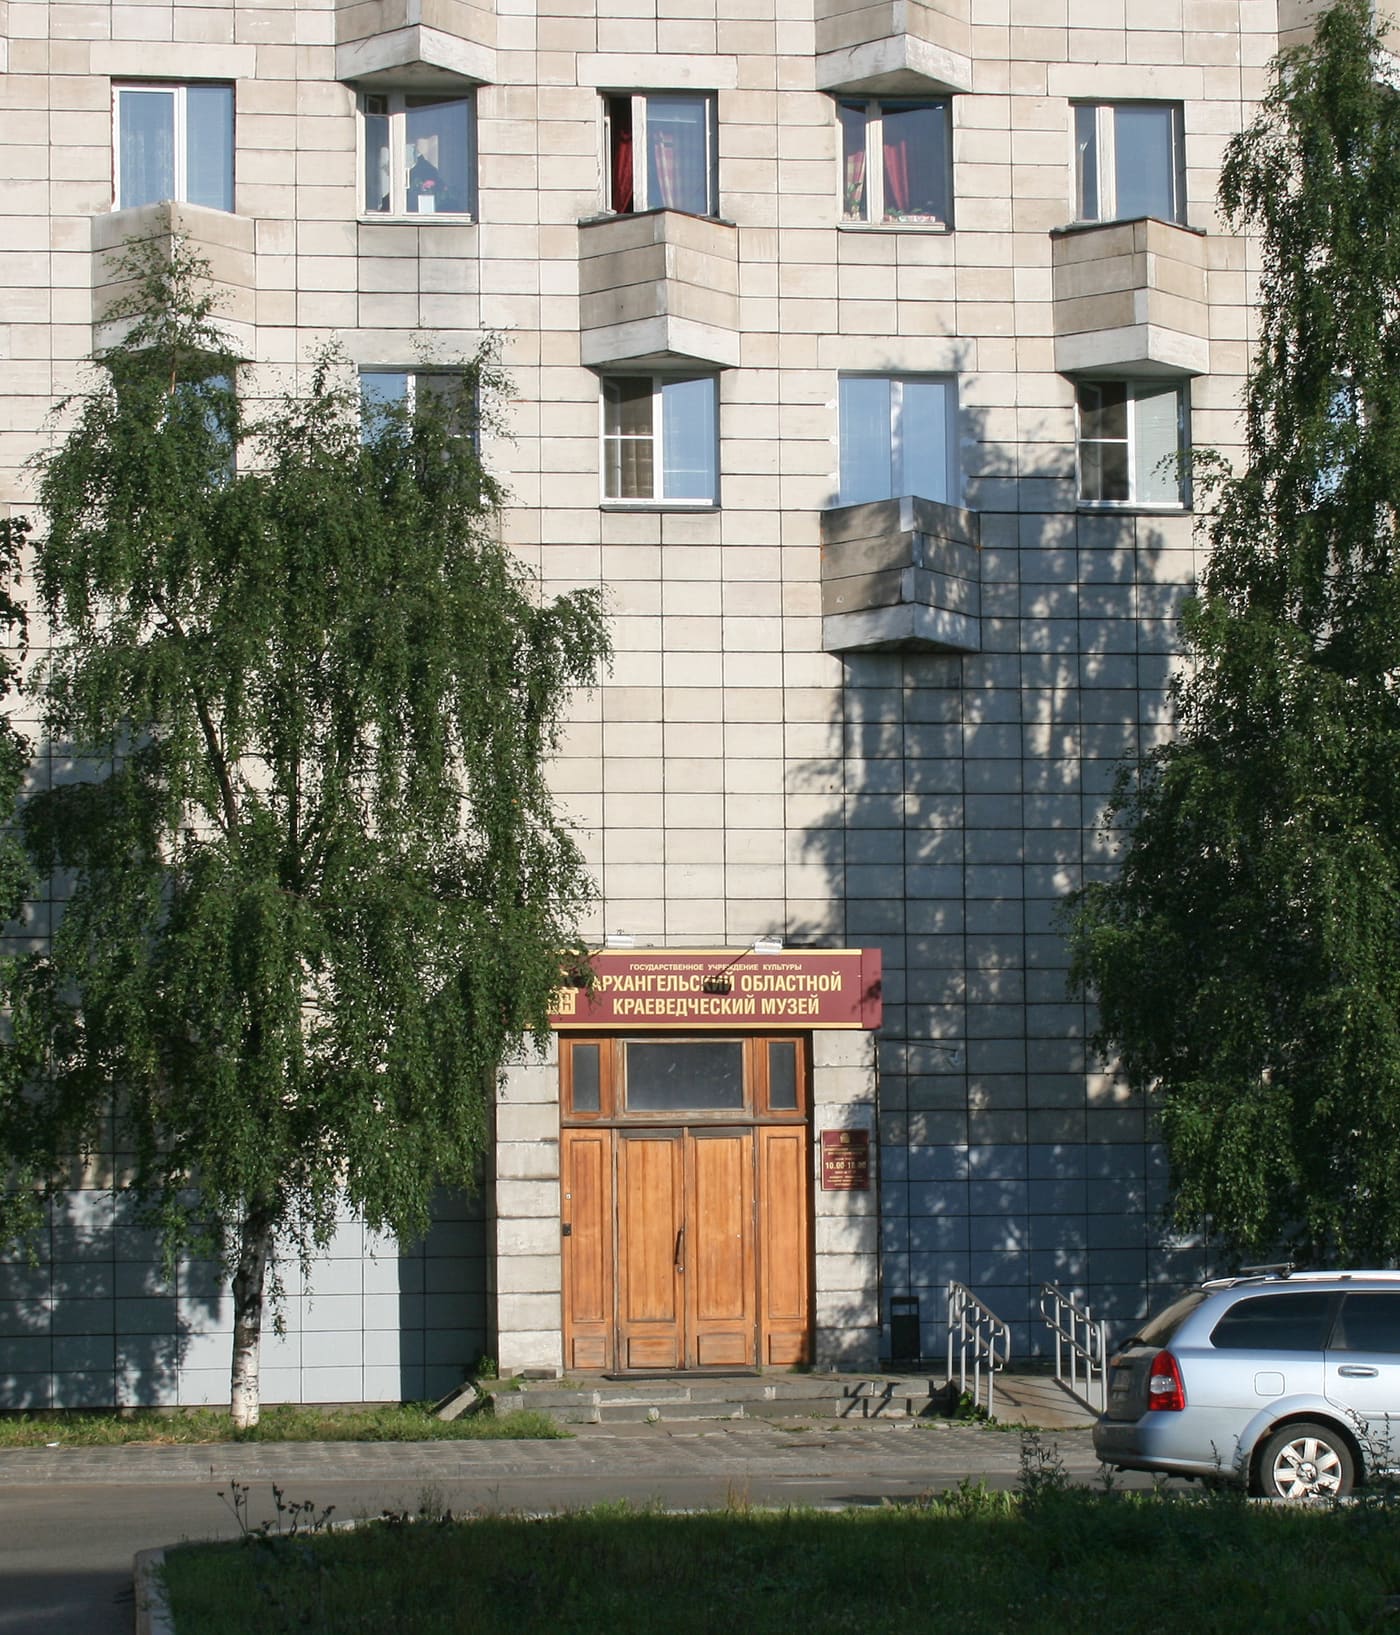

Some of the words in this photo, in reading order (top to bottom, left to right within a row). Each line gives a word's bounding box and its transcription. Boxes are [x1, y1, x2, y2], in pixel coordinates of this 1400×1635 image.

[629, 963, 704, 971] ГОСУДАРСТВЕННОЕ
[762, 963, 802, 971] КУЛЬТУРЫ
[740, 970, 842, 992] ОБЛАСТНОЙ
[613, 994, 756, 1016] КРАЕВЕДЧЕСКИЙ
[761, 994, 819, 1015] МУЗЕЙ
